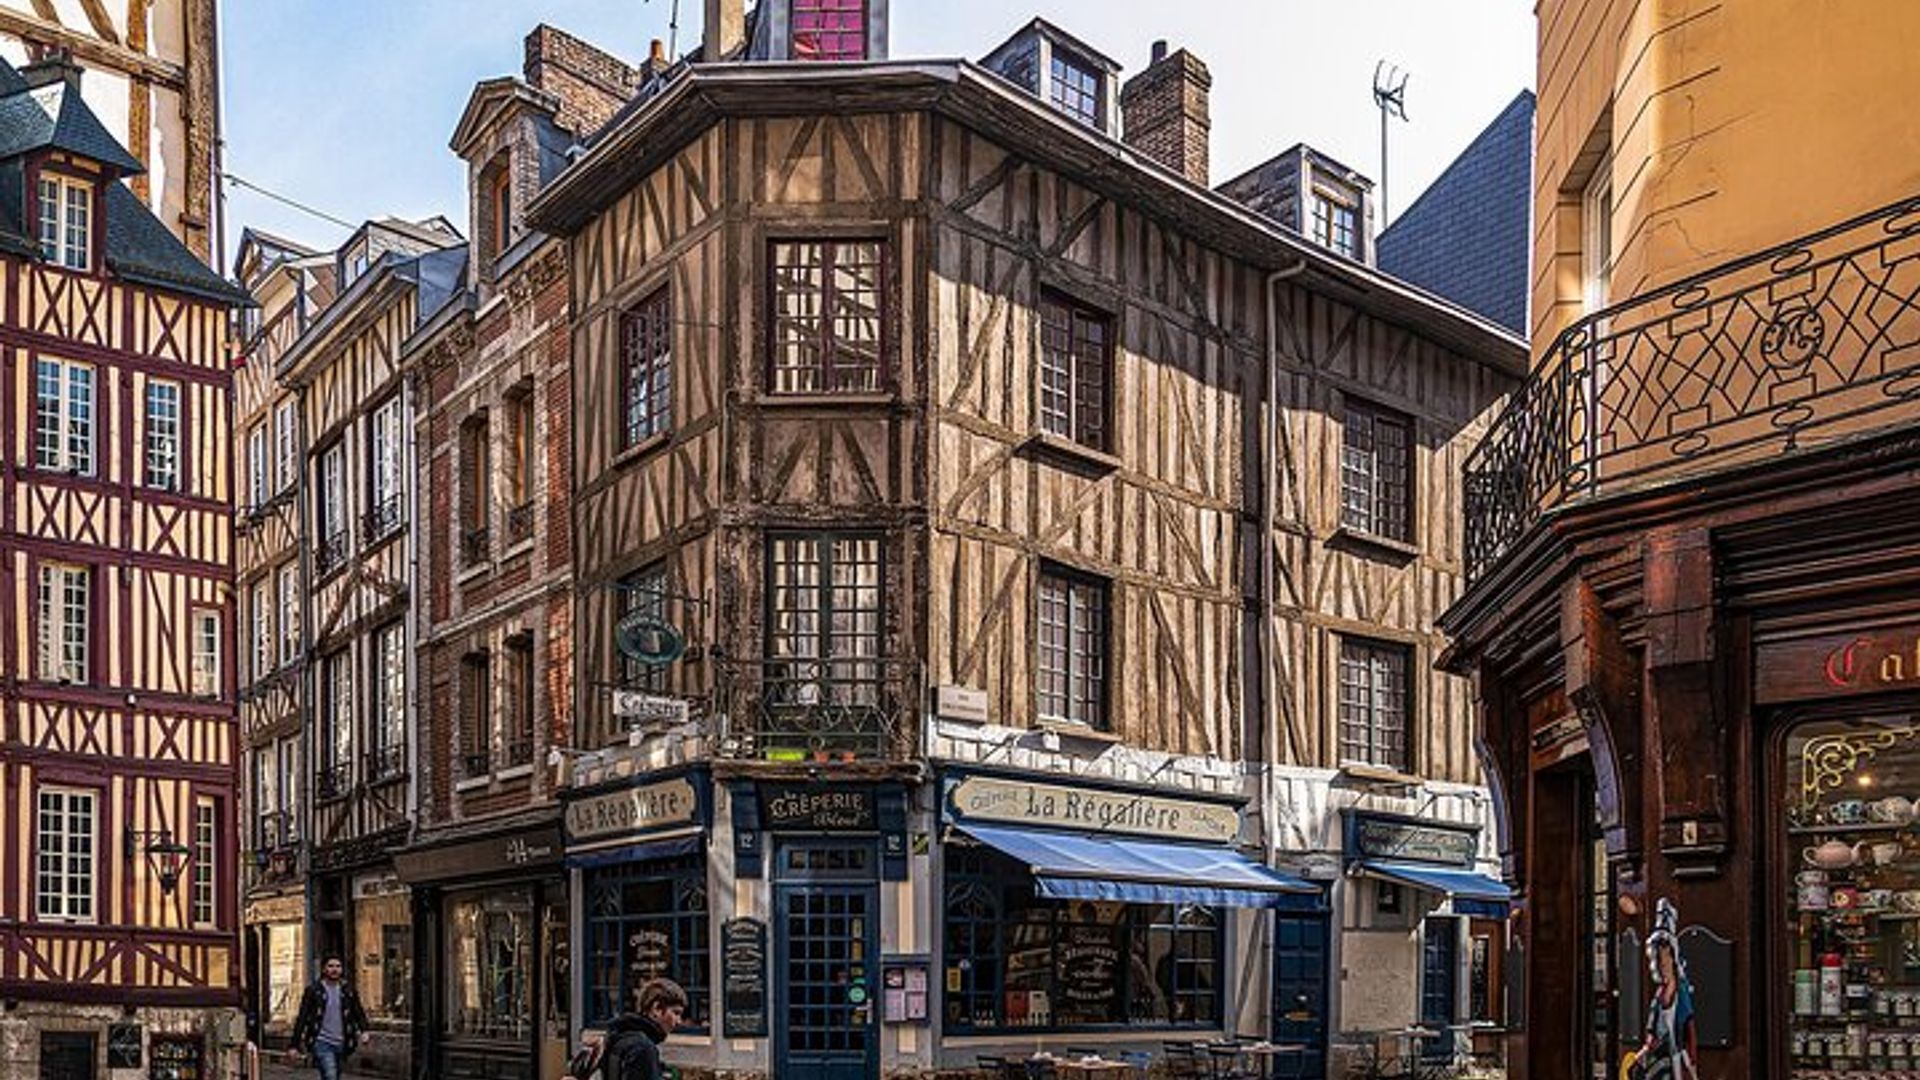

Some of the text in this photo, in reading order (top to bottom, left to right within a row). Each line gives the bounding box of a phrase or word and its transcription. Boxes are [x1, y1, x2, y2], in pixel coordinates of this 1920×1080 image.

[1824, 635, 1920, 686] Ca
[573, 804, 593, 829] La
[1024, 786, 1055, 816] La
[1065, 790, 1180, 830] Régalière
